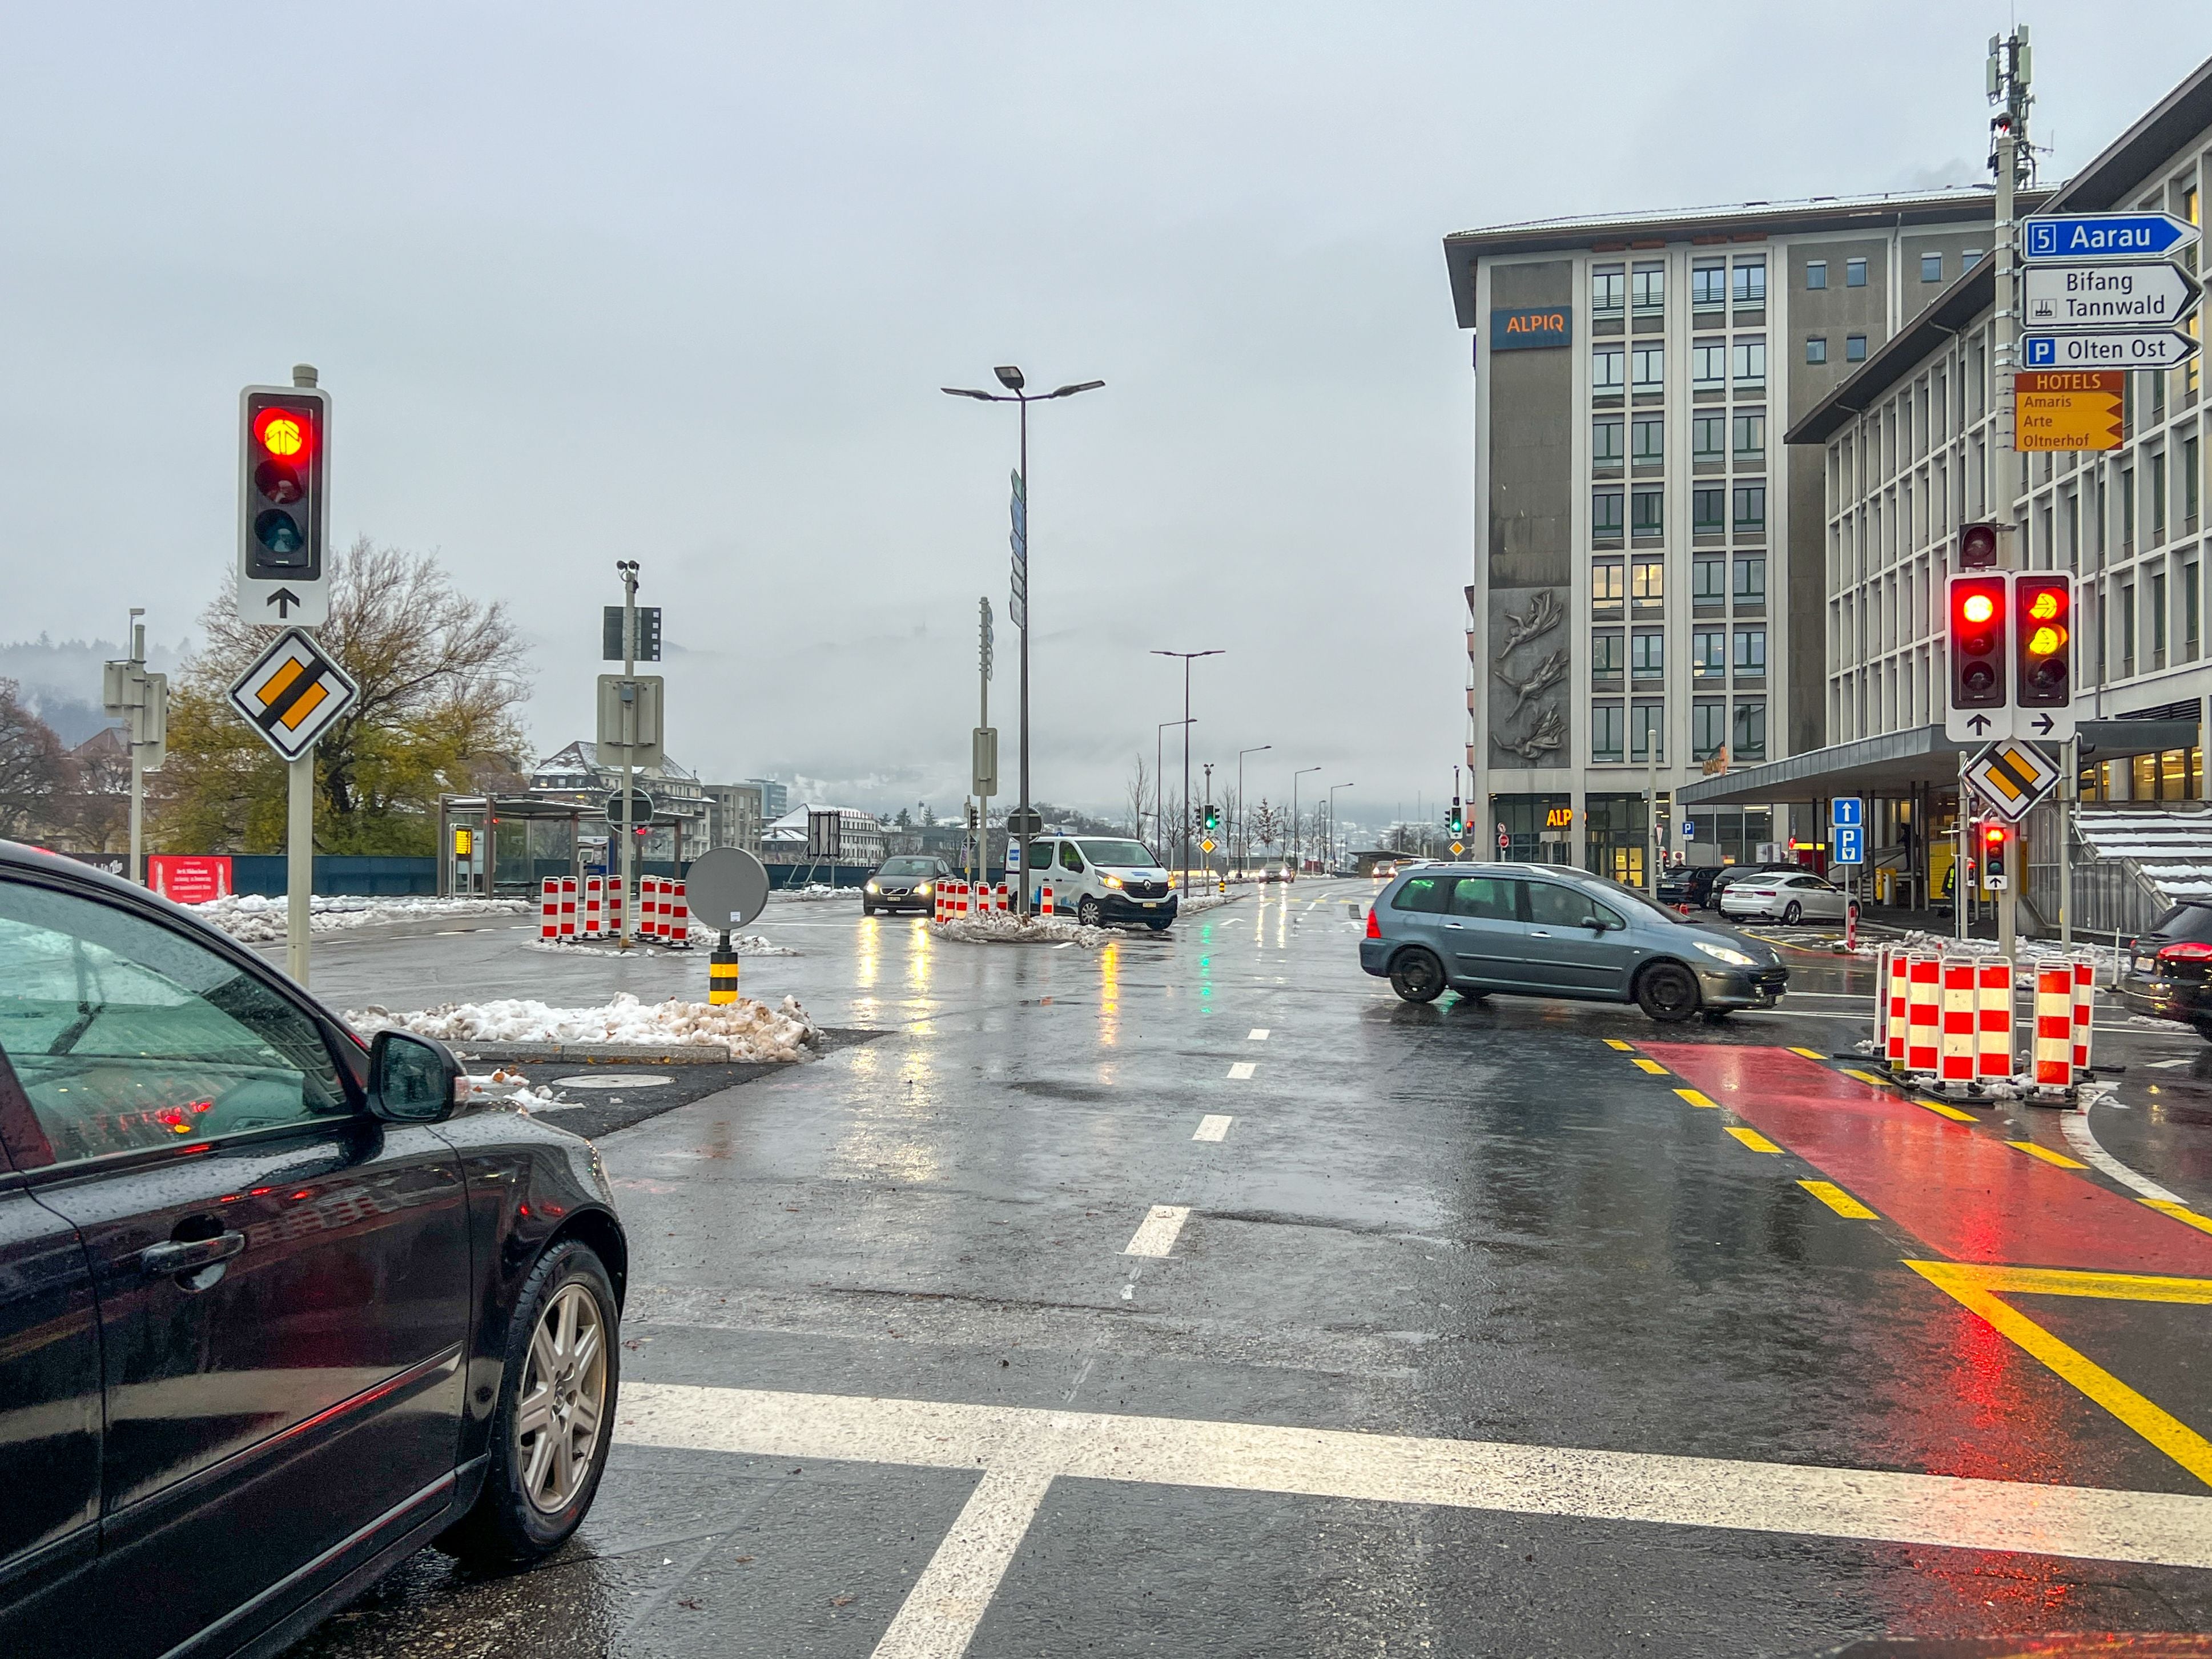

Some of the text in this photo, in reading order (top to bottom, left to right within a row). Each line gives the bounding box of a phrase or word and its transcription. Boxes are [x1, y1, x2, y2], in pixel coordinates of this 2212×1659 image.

[2038, 226, 2150, 249] 5 Aarau
[2066, 271, 2133, 295] Bifang
[2066, 295, 2165, 317] Tannwald
[1506, 313, 1564, 332] ALPIQ
[2035, 339, 2166, 362] P Olten Ost
[2036, 374, 2101, 389] HOTELS
[2024, 395, 2072, 408] Amaris
[2023, 416, 2053, 427] Arte
[2023, 433, 2090, 448] Oltnerhof
[1546, 808, 1587, 827] ALP
[1684, 823, 1691, 834] P
[1842, 830, 1855, 847] P
